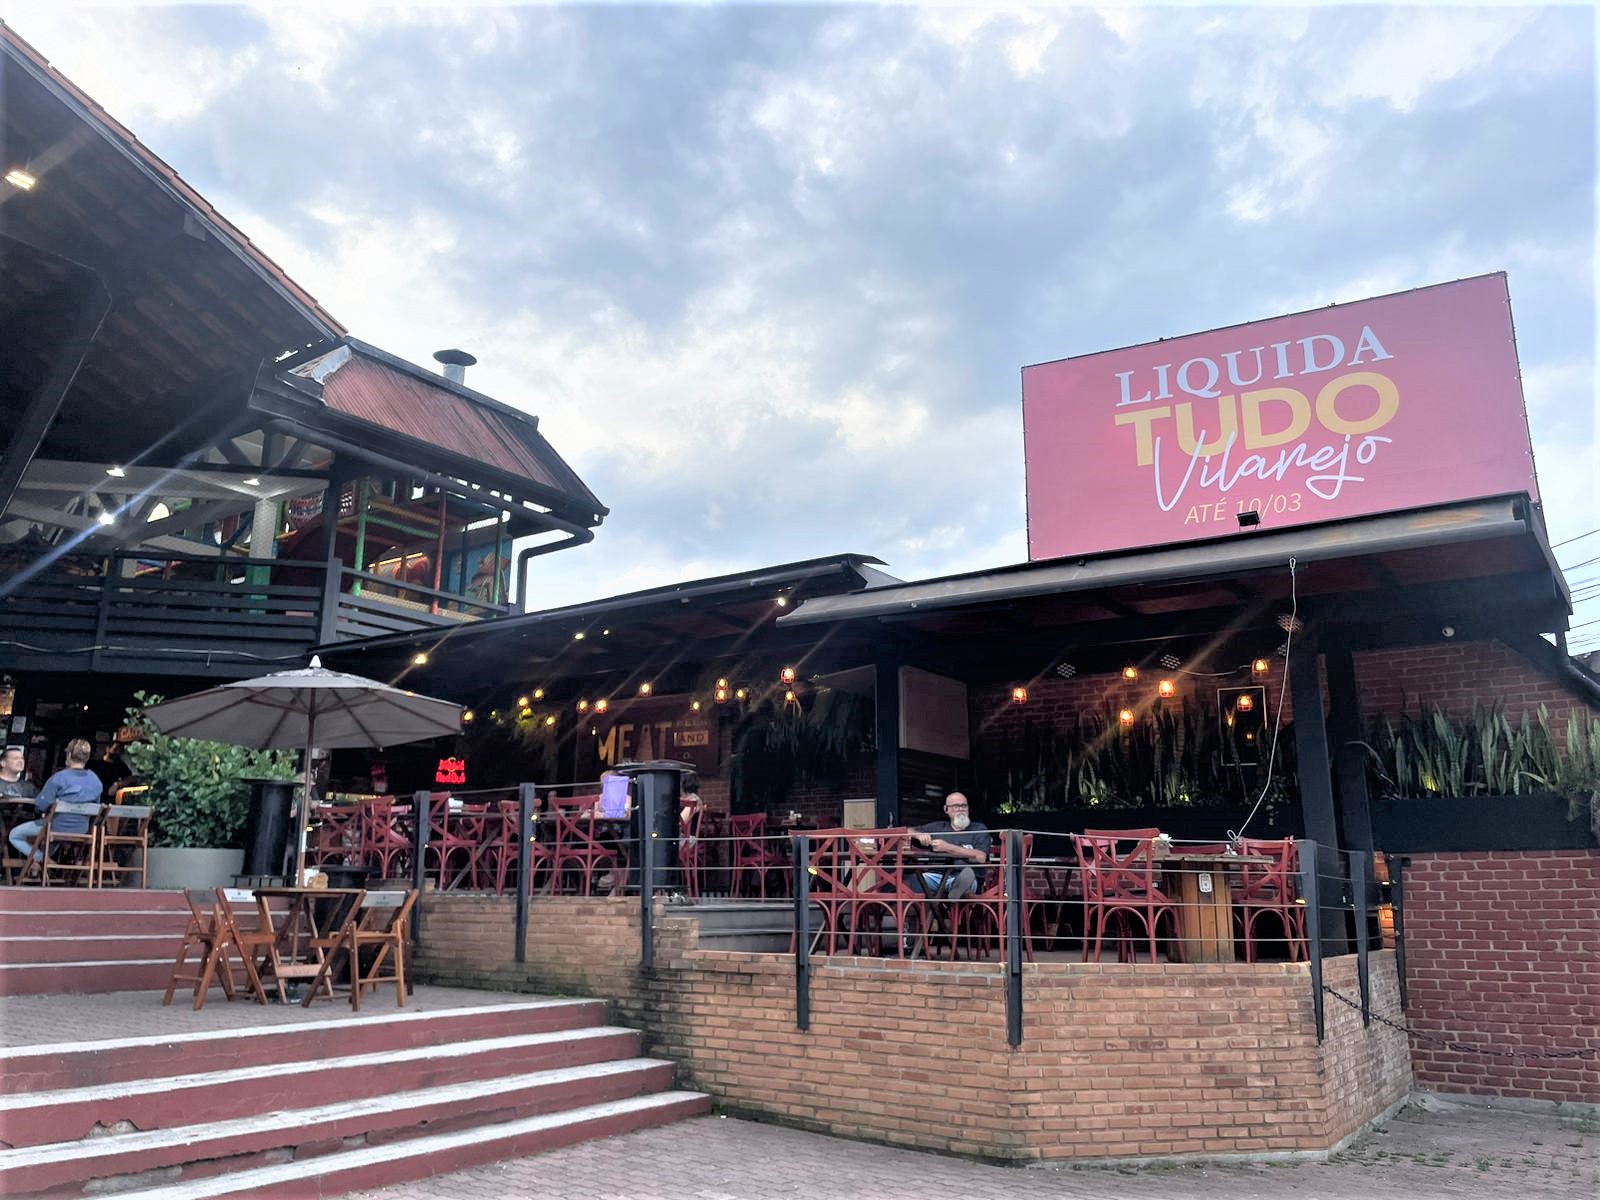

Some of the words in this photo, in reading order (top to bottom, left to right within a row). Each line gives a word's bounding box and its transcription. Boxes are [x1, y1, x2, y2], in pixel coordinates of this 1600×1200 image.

[1114, 325, 1394, 407] LIQUIDA
[1114, 371, 1400, 467] TUDO
[1184, 497, 1227, 525] ATÉ
[1234, 492, 1302, 520] 10/03
